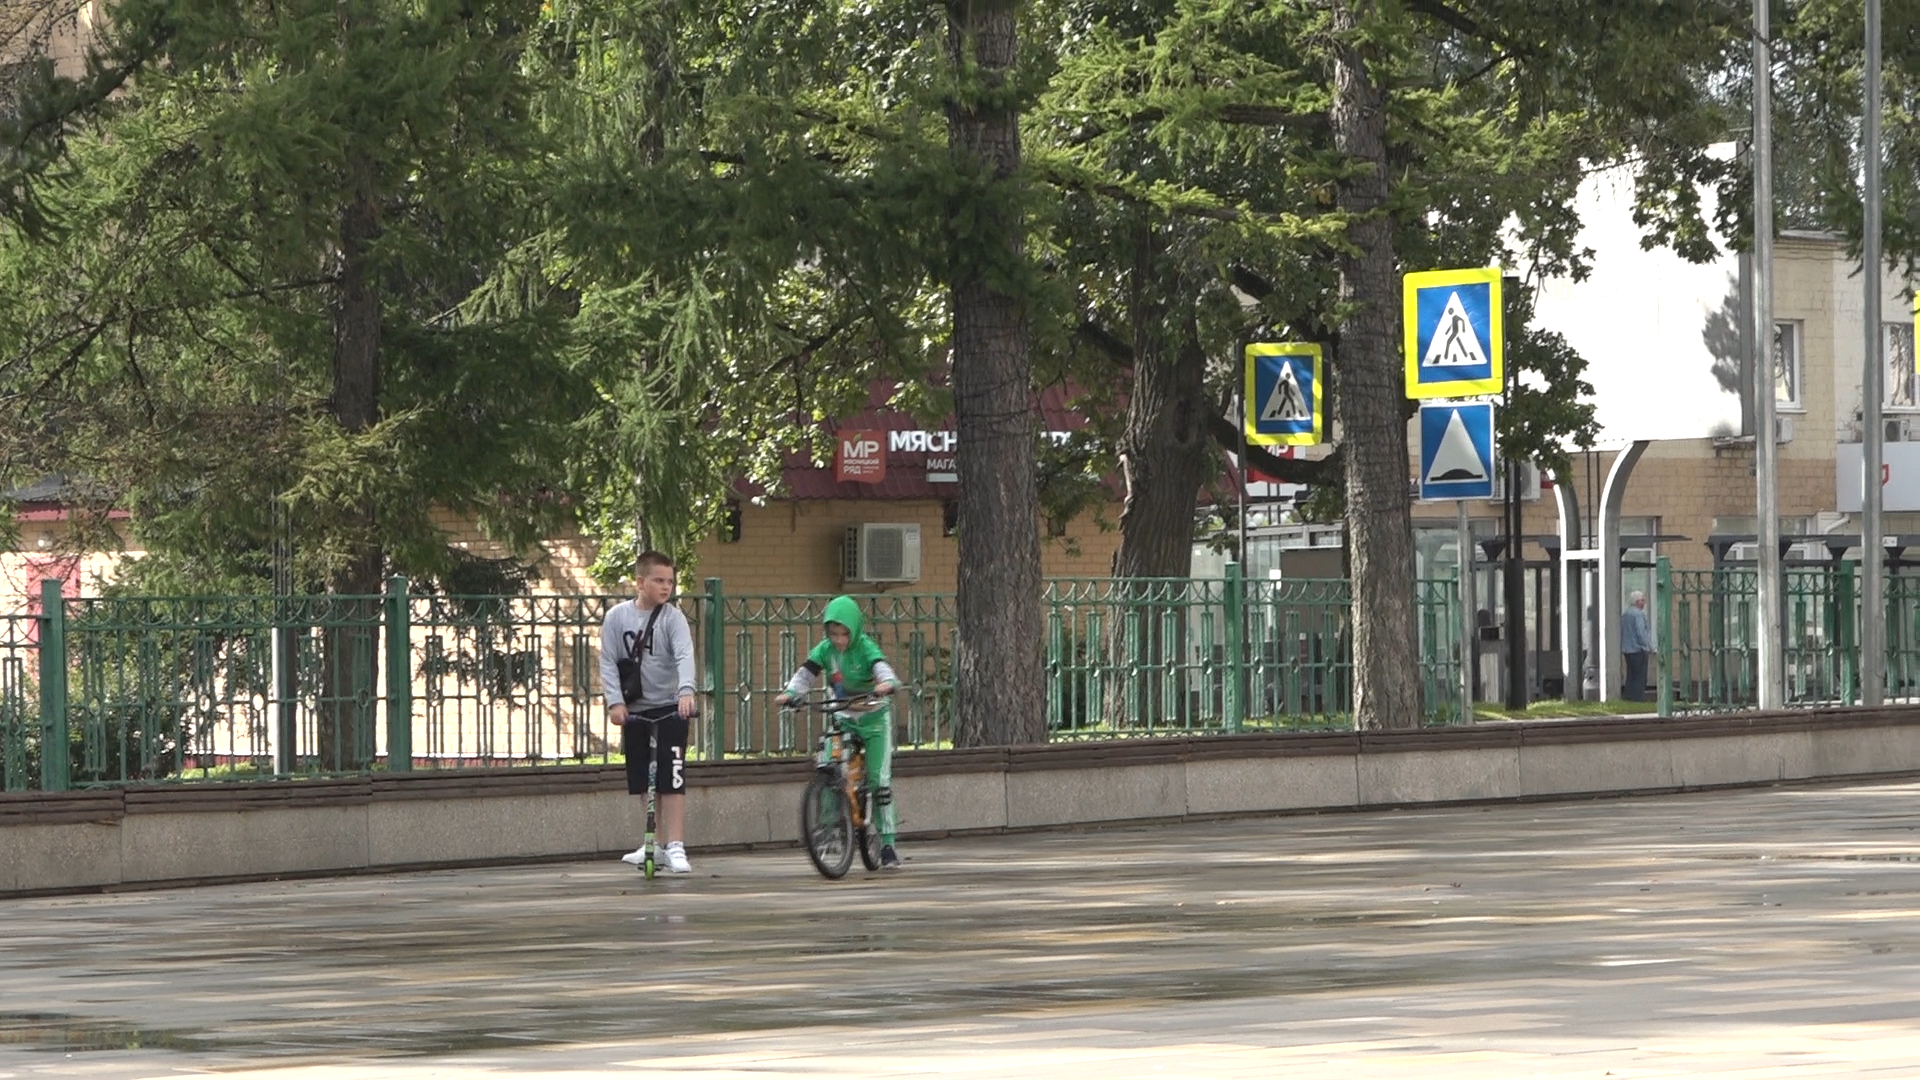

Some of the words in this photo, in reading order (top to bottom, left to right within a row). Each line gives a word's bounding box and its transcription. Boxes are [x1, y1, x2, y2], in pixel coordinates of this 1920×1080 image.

[843, 440, 879, 458] МР
[888, 430, 958, 452] МЯСН
[926, 458, 957, 470] МАГА
[671, 746, 684, 790] FILA
